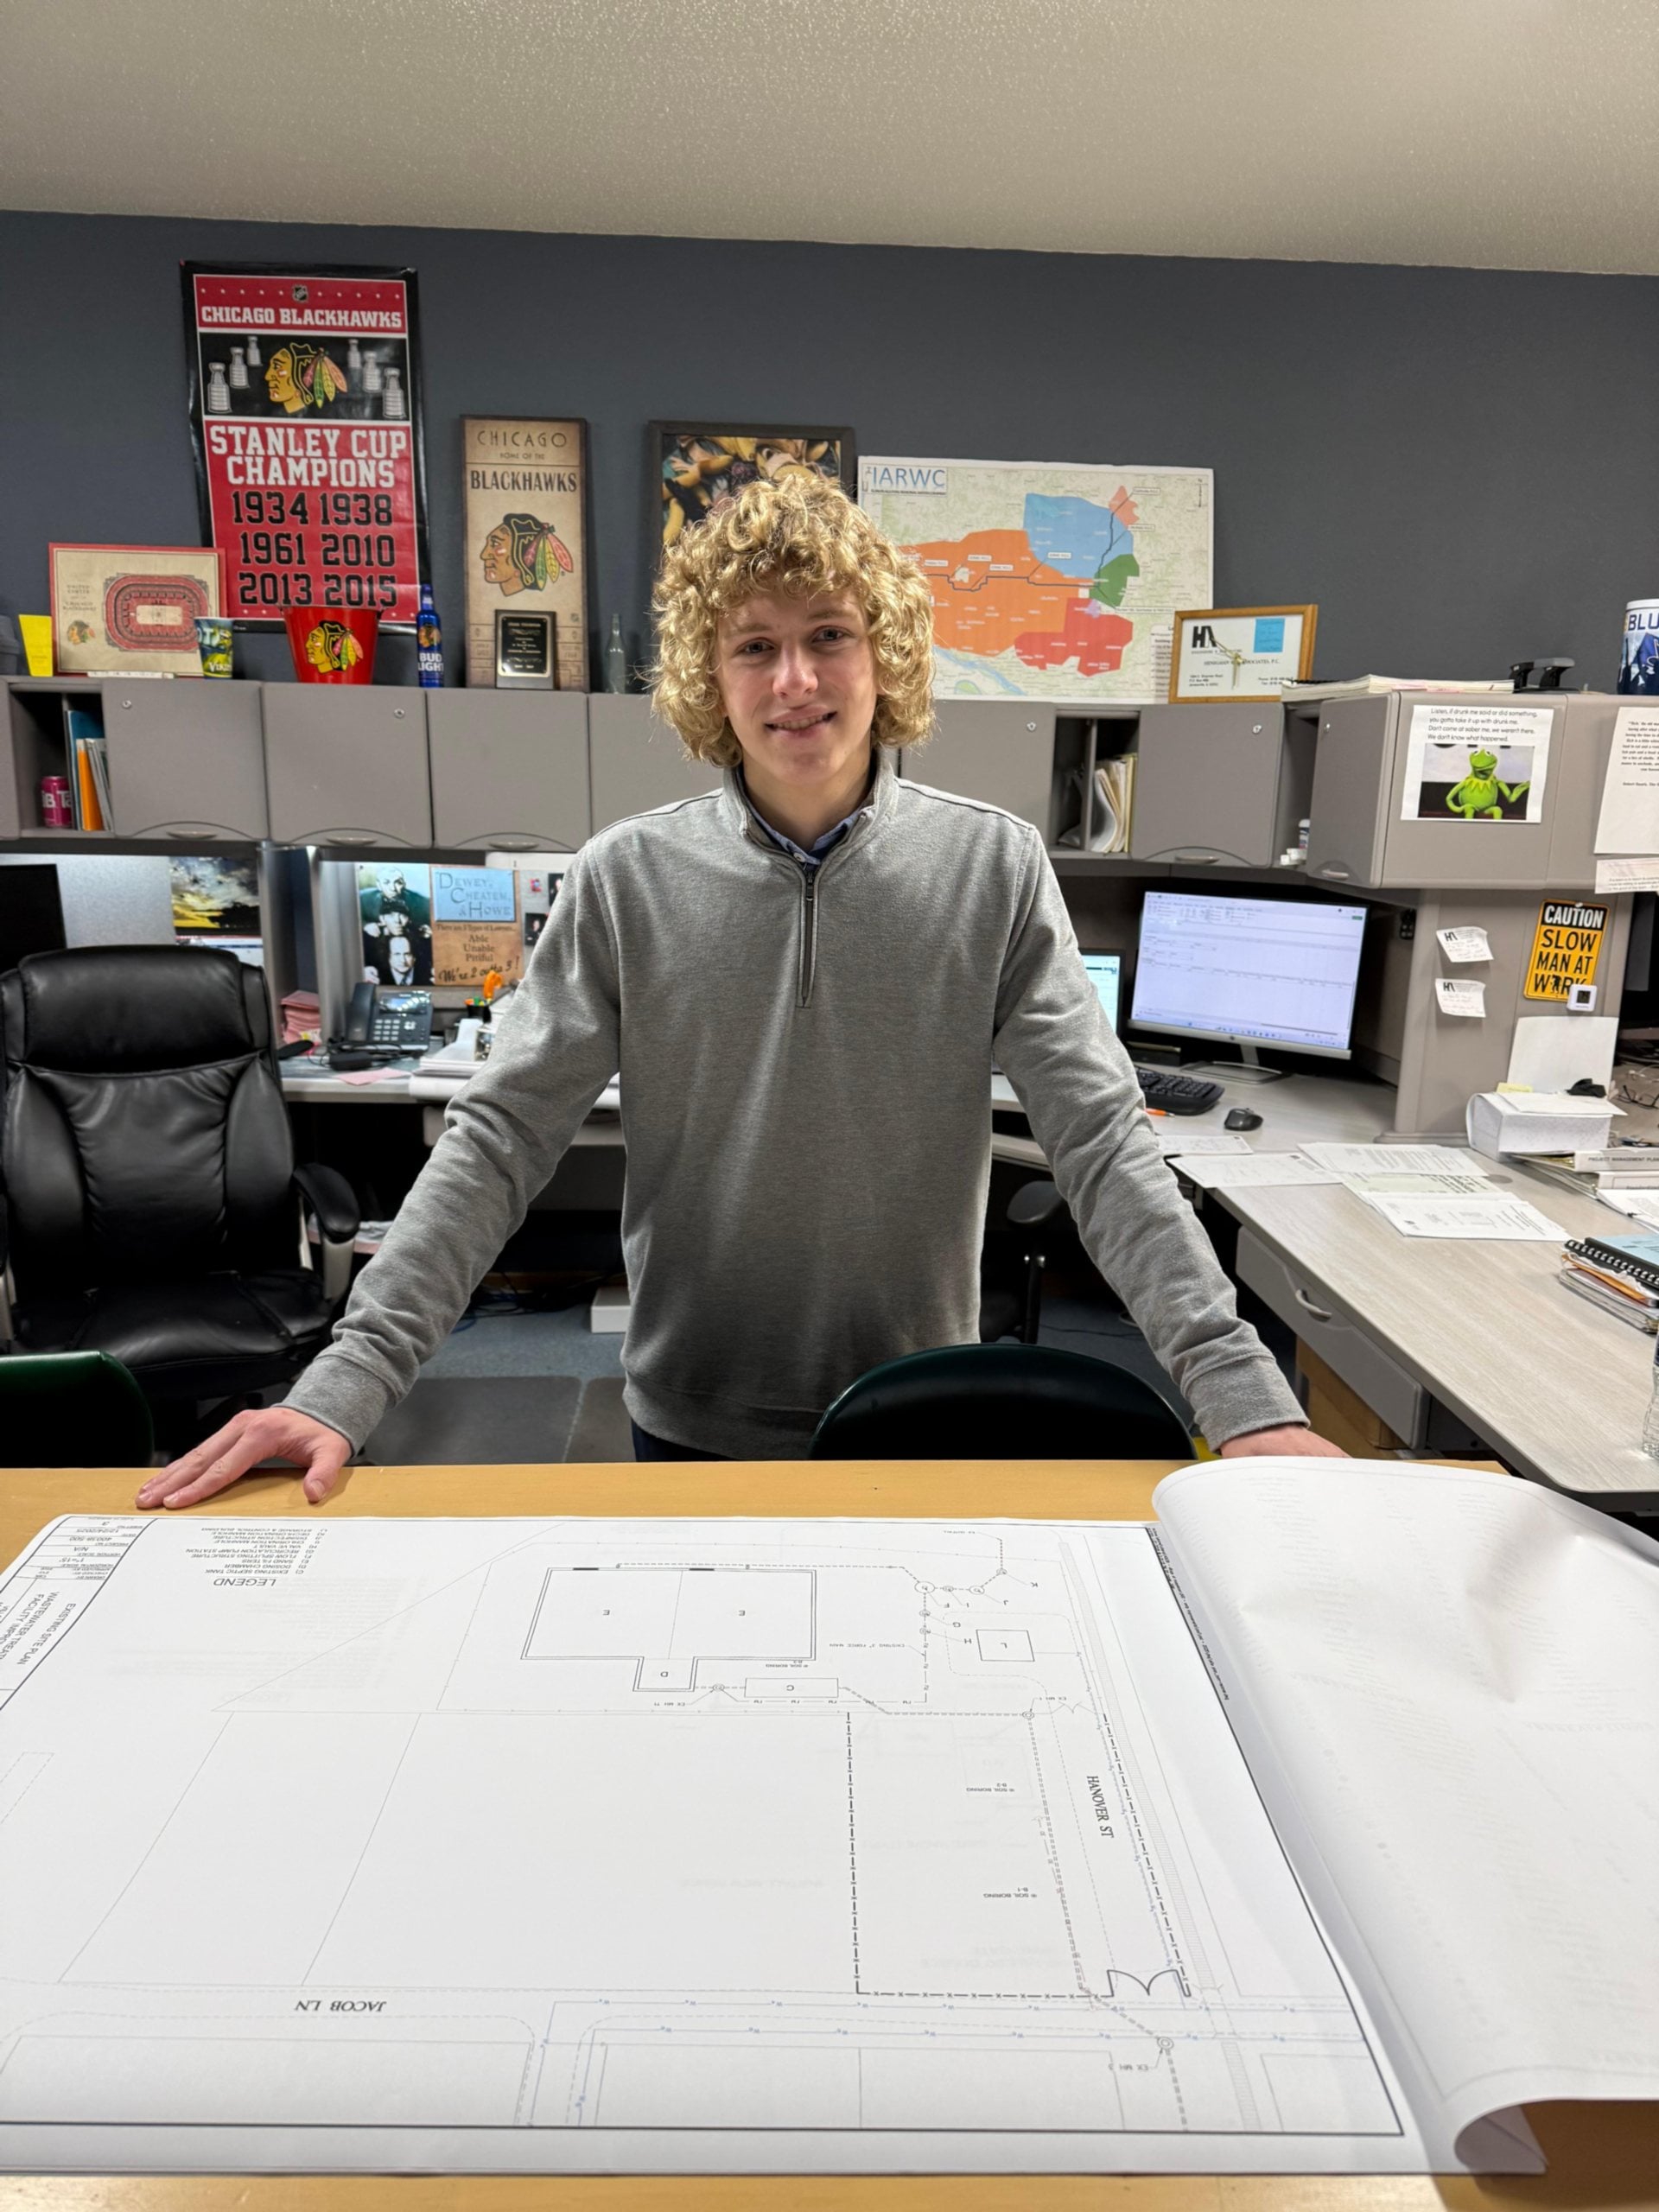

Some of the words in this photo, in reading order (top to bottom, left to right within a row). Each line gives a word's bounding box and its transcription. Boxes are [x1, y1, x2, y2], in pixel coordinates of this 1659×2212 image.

[201, 306, 275, 324] CHICAGO
[279, 308, 402, 327] BLACKHAWKS
[210, 425, 340, 457] STANLEY
[351, 429, 406, 459] CUP
[477, 430, 567, 448] CHICAGO
[226, 455, 395, 487] CHAMPIONS
[471, 470, 577, 493] BLACKHAWKS
[873, 467, 945, 487] IARWC
[232, 491, 308, 525] 1934
[320, 493, 393, 526] 1938
[240, 531, 307, 566] 1961
[321, 533, 396, 567] 2010
[238, 572, 312, 606] 2013
[323, 574, 397, 607] 2015
[419, 652, 442, 663] BUD
[1544, 905, 1605, 929] CAUTION
[463, 944, 494, 952] Unable
[468, 934, 488, 943] Able
[1541, 929, 1597, 952] SLOW
[466, 953, 493, 962] Pitiful
[1536, 951, 1571, 973] MAN
[1573, 956, 1593, 975] AT
[438, 967, 468, 982] We're
[470, 966, 478, 978] 2
[213, 1578, 277, 1586] LEGEND
[15, 1591, 60, 1636] WASTEWATER
[16, 1593, 44, 1622] FACILITY
[47, 1603, 76, 1632] EXISTING
[0, 1637, 22, 1660] TREAT
[32, 1633, 52, 1647] SITE
[16, 1648, 39, 1665] PLAN
[1086, 1776, 1109, 1822] HANOVER
[1099, 1825, 1115, 1839] ST
[294, 1999, 321, 2012] LN
[330, 2000, 387, 2012] JACOB
